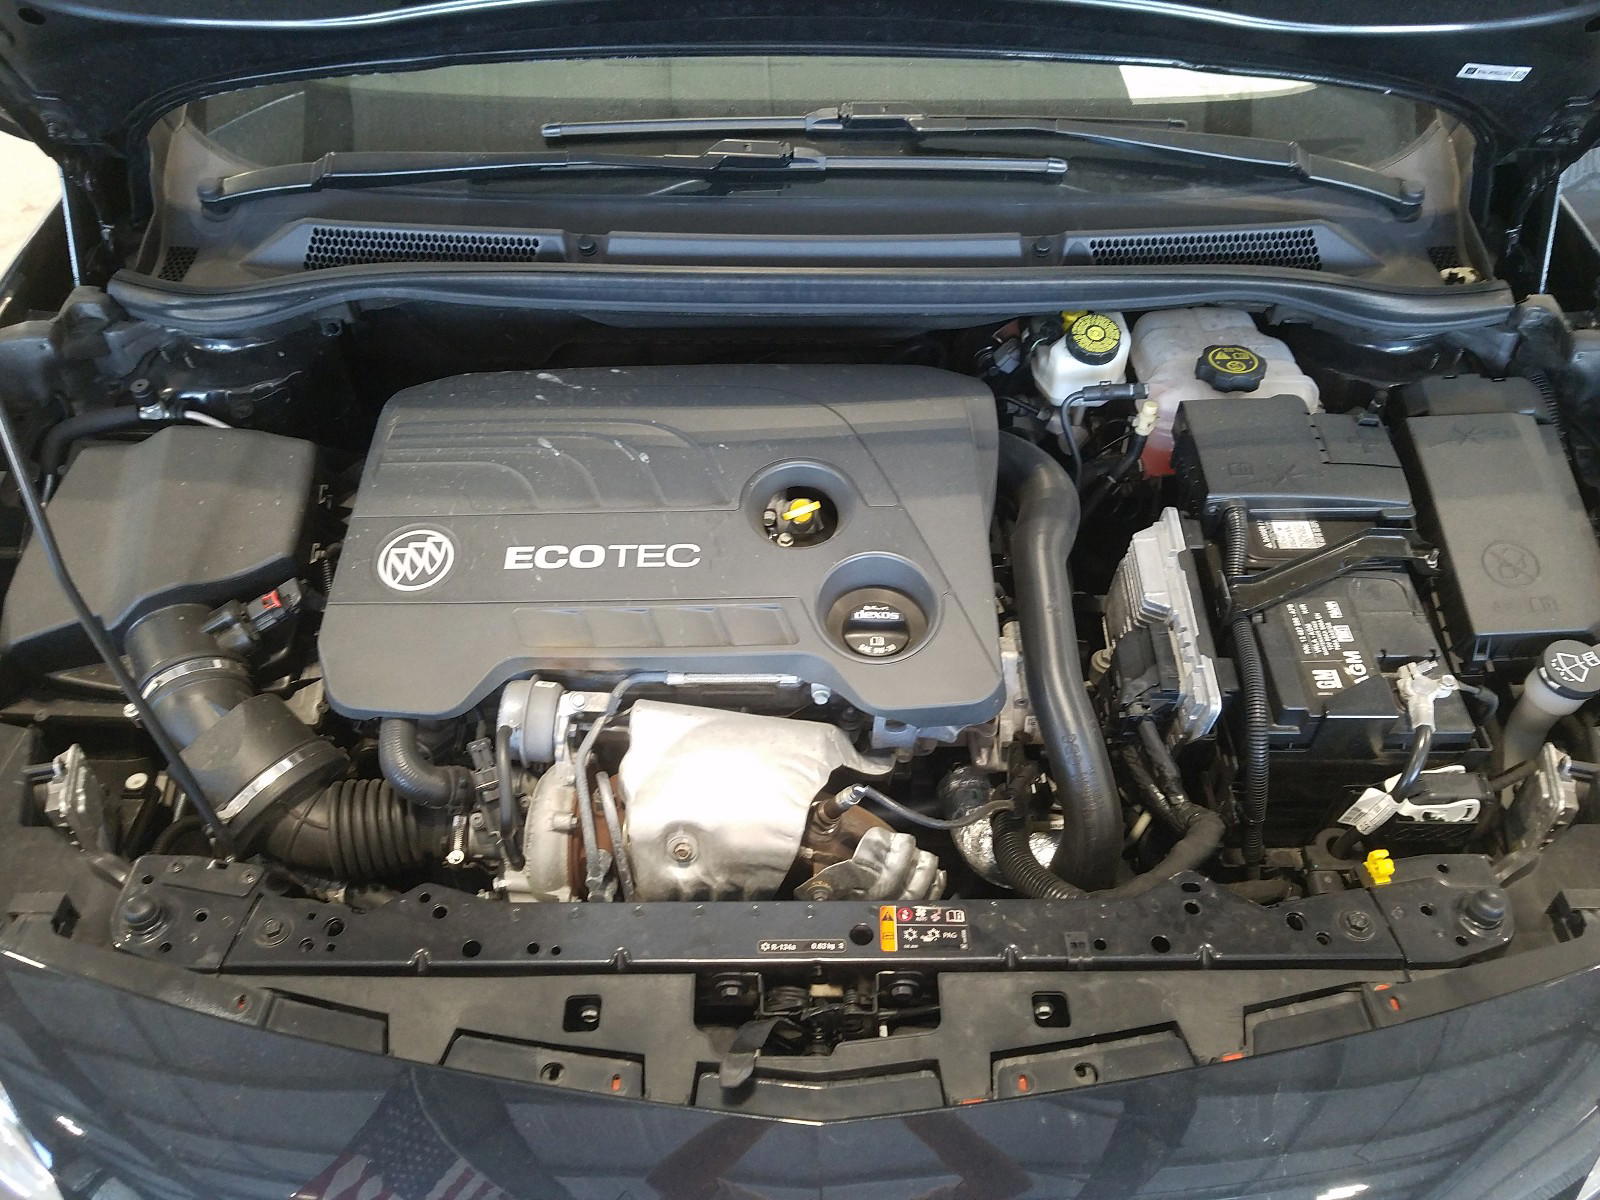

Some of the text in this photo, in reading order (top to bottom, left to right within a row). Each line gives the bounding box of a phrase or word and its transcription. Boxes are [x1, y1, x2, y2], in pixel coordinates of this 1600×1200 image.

[504, 543, 701, 570] ECOTEC
[854, 610, 900, 620] dexos
[1312, 669, 1339, 690] GM
